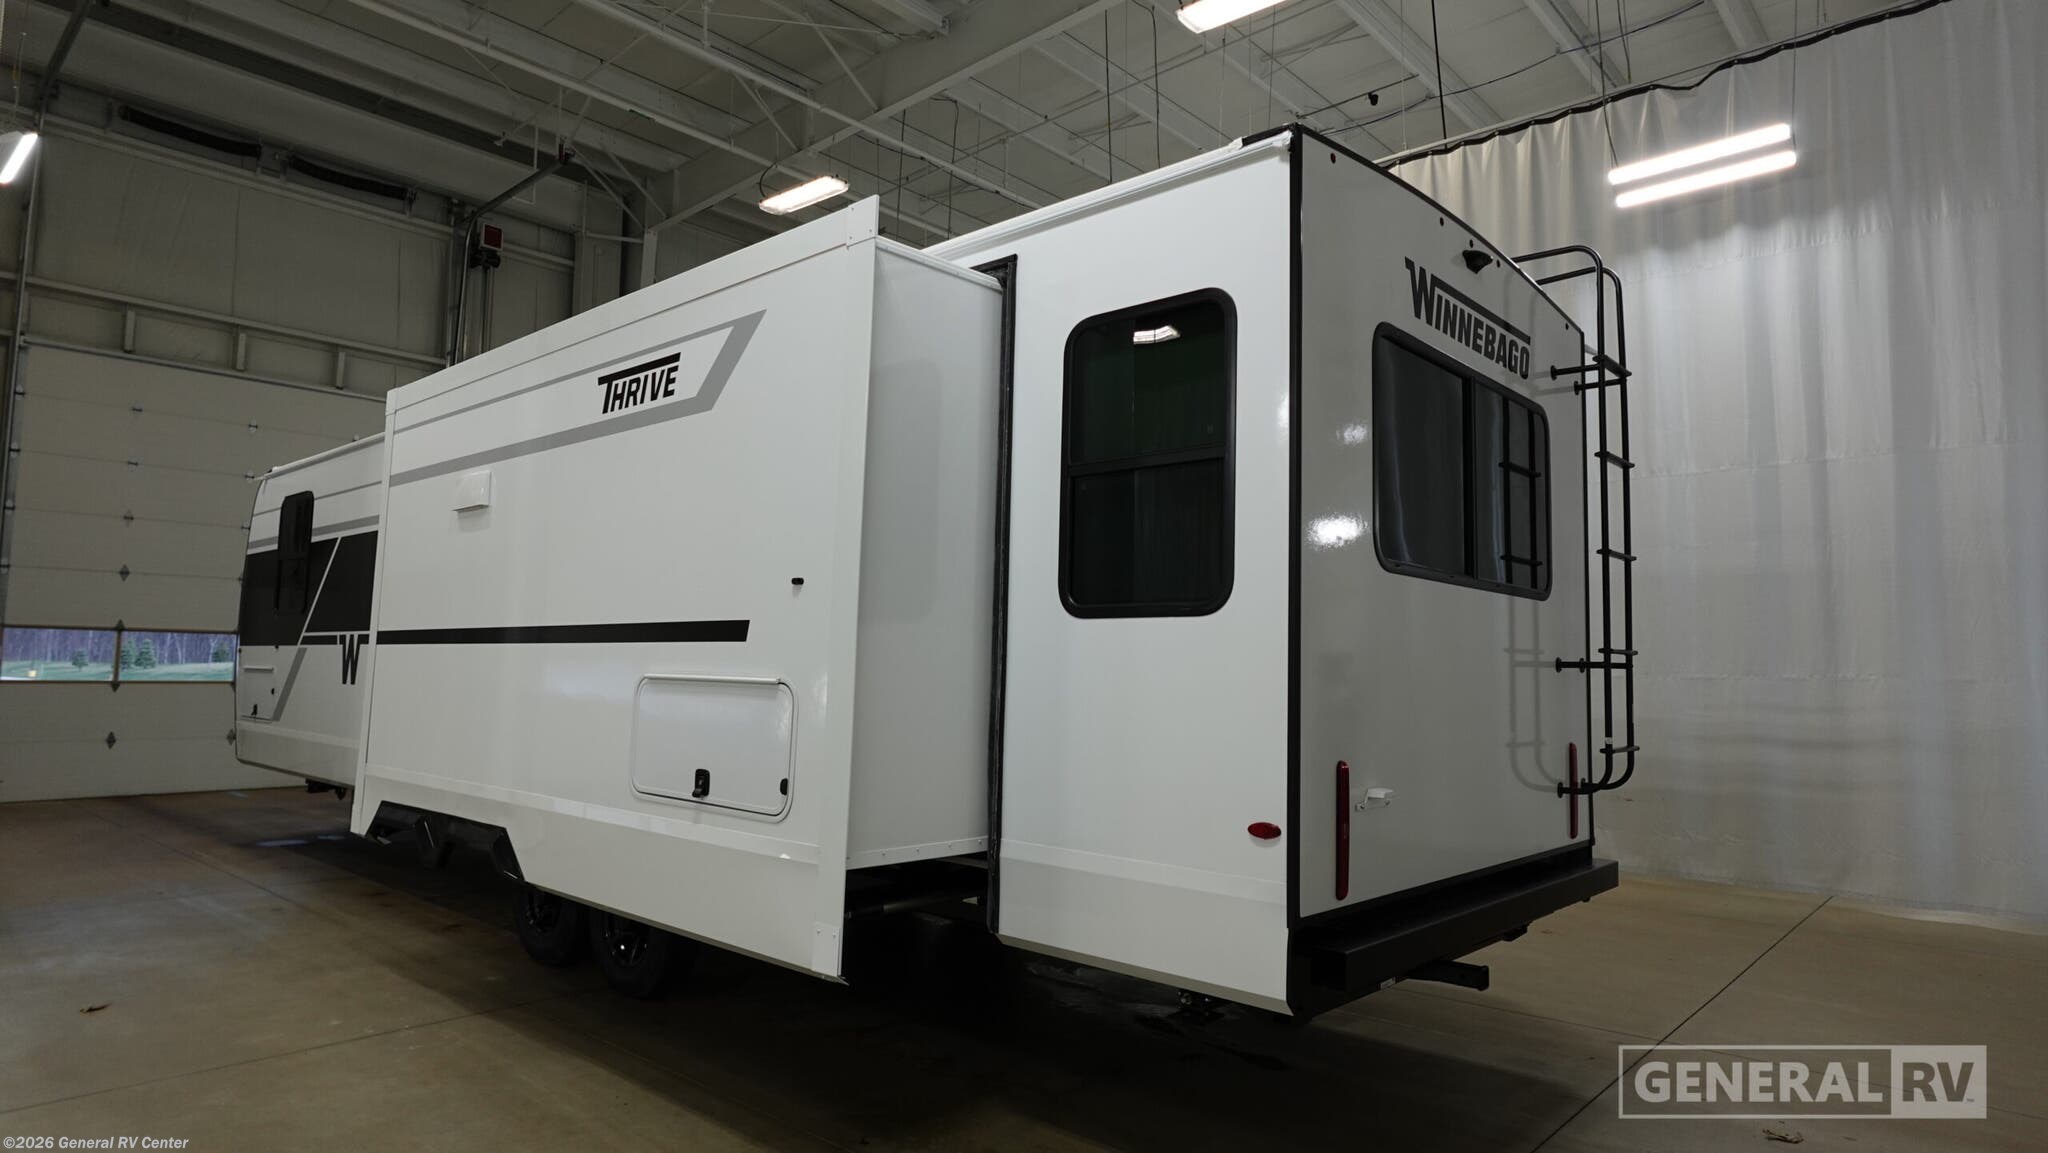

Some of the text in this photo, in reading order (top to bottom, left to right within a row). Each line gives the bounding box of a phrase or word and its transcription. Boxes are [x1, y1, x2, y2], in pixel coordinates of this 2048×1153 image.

[1405, 256, 1531, 379] WINNEBAGO
[598, 352, 681, 414] THRIVE
[339, 634, 367, 685] W
